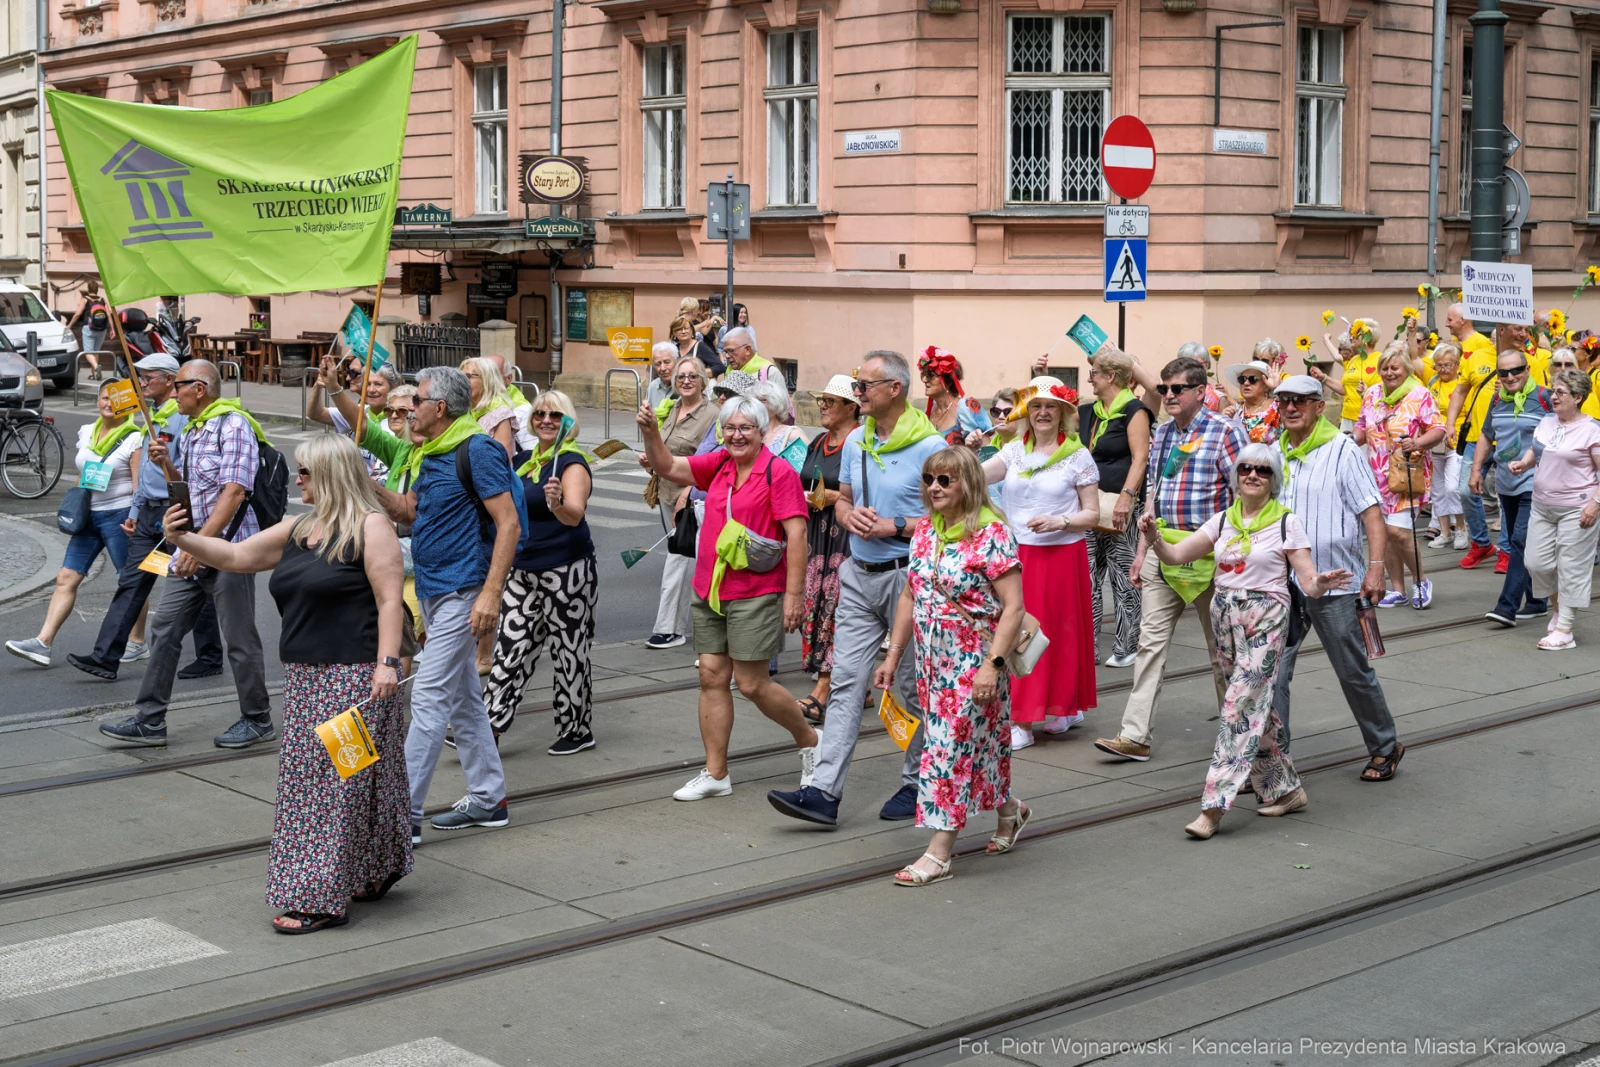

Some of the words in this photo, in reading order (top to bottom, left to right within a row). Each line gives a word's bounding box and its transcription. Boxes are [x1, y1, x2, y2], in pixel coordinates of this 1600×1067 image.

[846, 140, 899, 151] JABŁONOWSKICH
[1218, 140, 1264, 151] STRASZEWSKIEGO
[533, 175, 554, 190] Stary
[554, 175, 570, 188] Port
[253, 198, 348, 219] TRZECIEGO
[352, 192, 386, 214] WIEKU
[405, 213, 448, 222] TAWERNA
[1108, 208, 1120, 216] Nie
[1122, 208, 1148, 219] dotyczy
[530, 224, 579, 233] TAWERNA
[1478, 271, 1516, 282] MEDYCZNY
[1472, 283, 1522, 295] UNIWERSYTET
[1466, 294, 1505, 306] TRZECIEGO
[1505, 297, 1530, 309] WIEKU
[1469, 307, 1480, 316] WE
